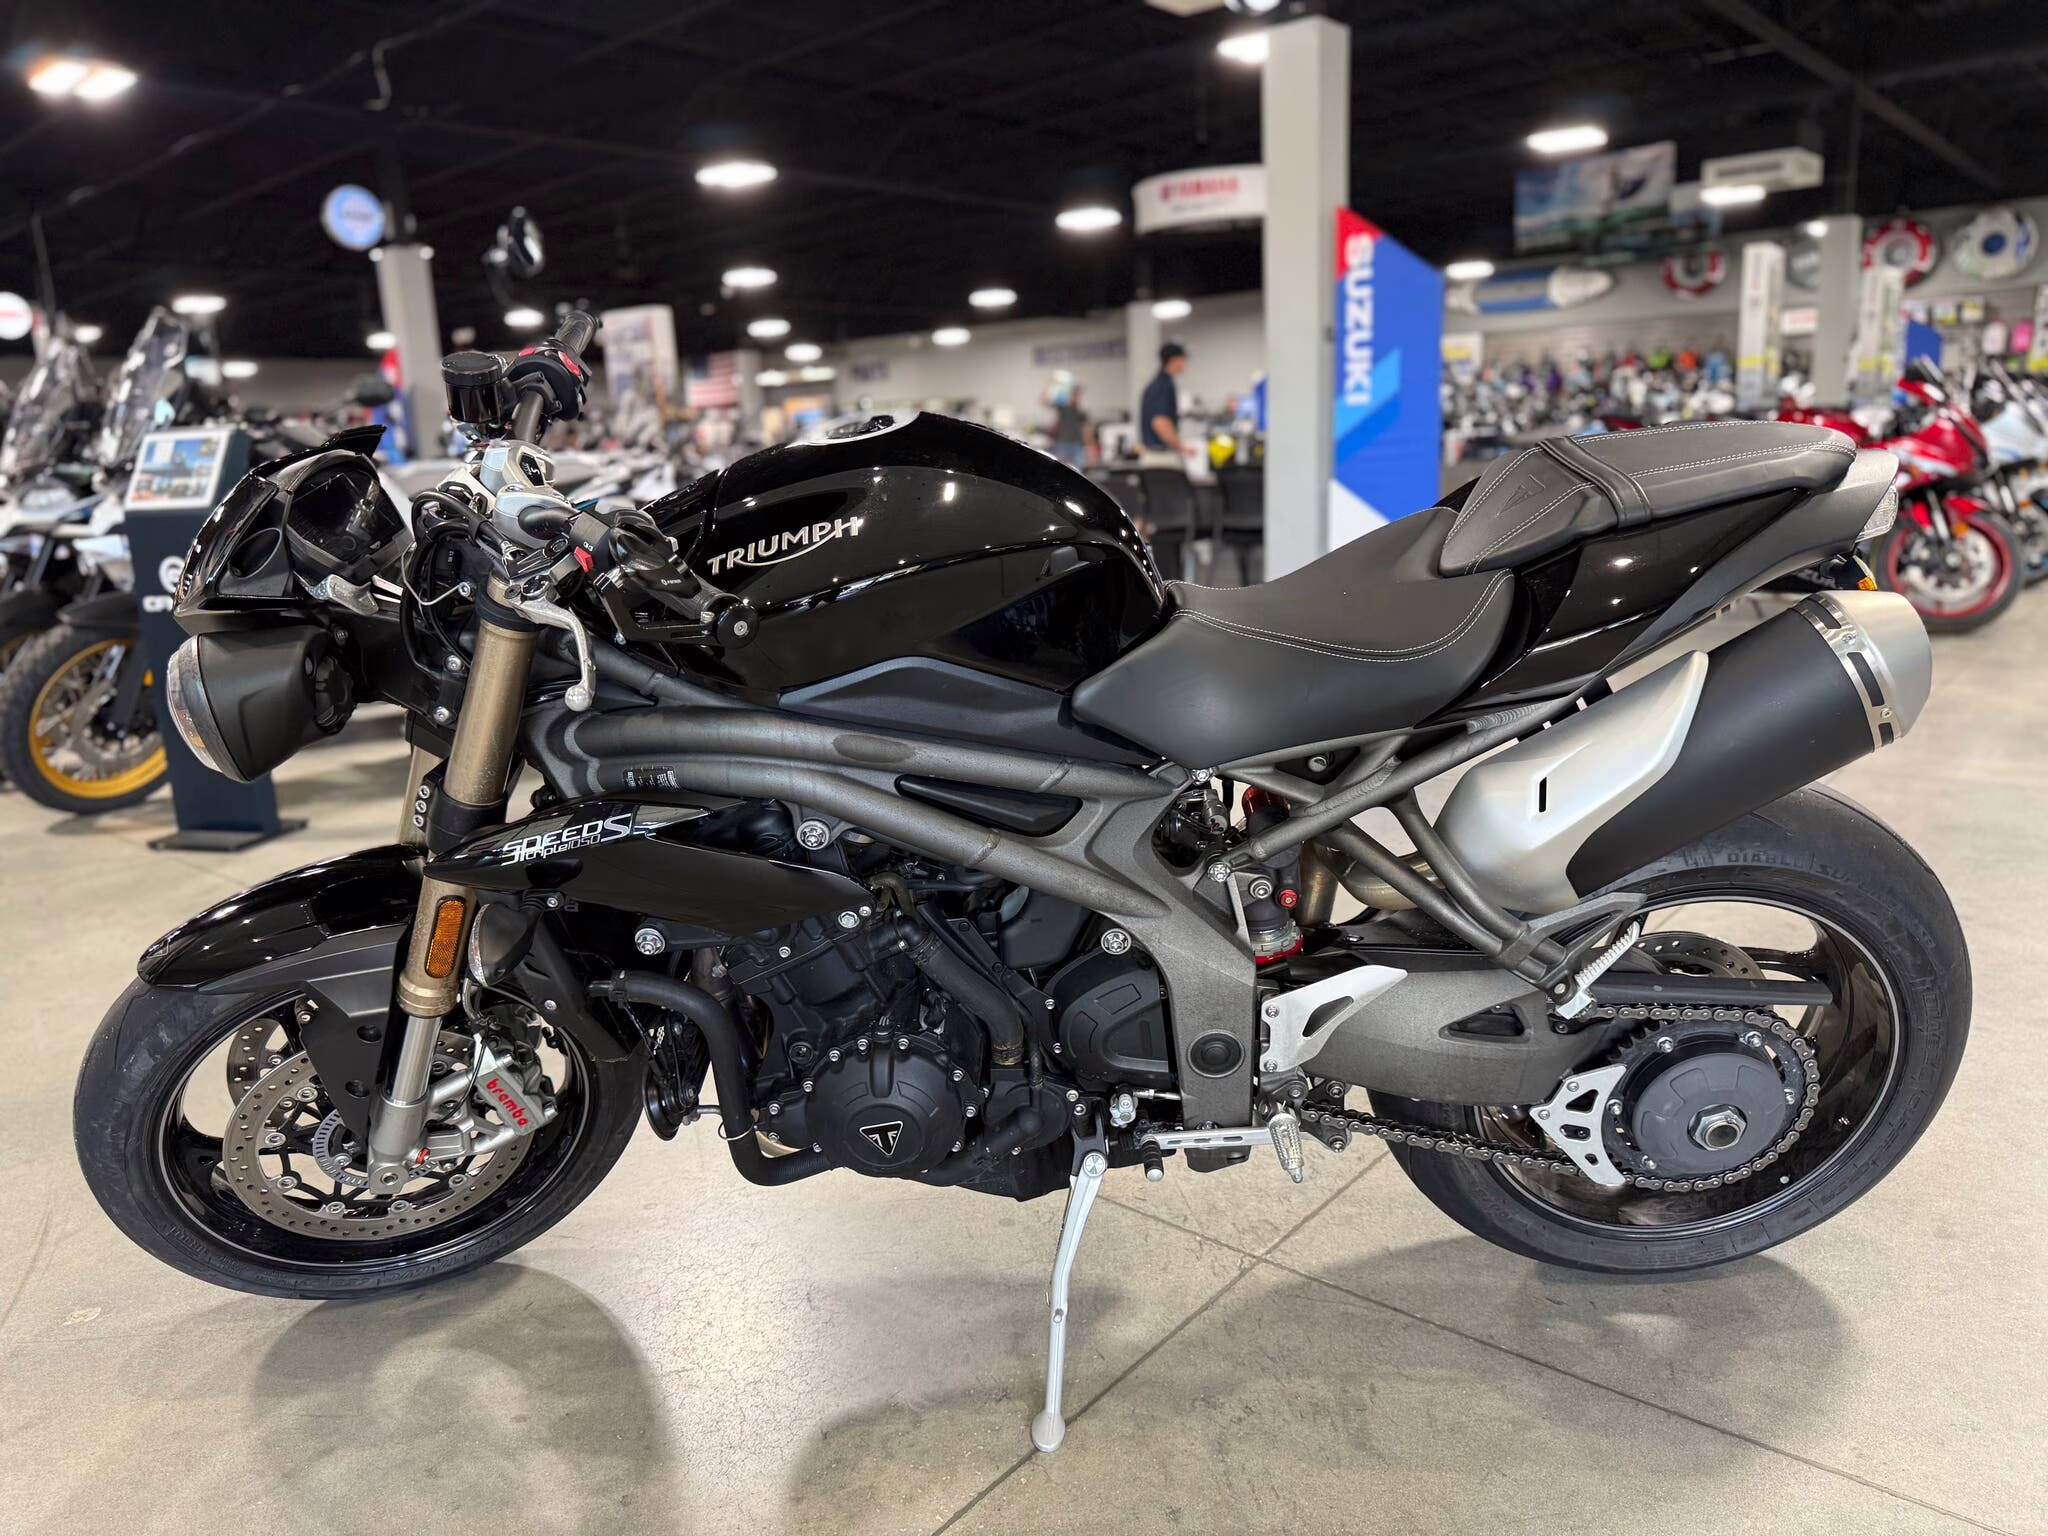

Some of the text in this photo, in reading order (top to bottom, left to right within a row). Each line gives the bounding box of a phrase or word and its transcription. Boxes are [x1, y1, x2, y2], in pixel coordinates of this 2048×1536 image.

[1344, 233, 1374, 405] SUZUKI
[707, 516, 861, 575] TRIUMPH
[486, 1078, 529, 1127] brembo
